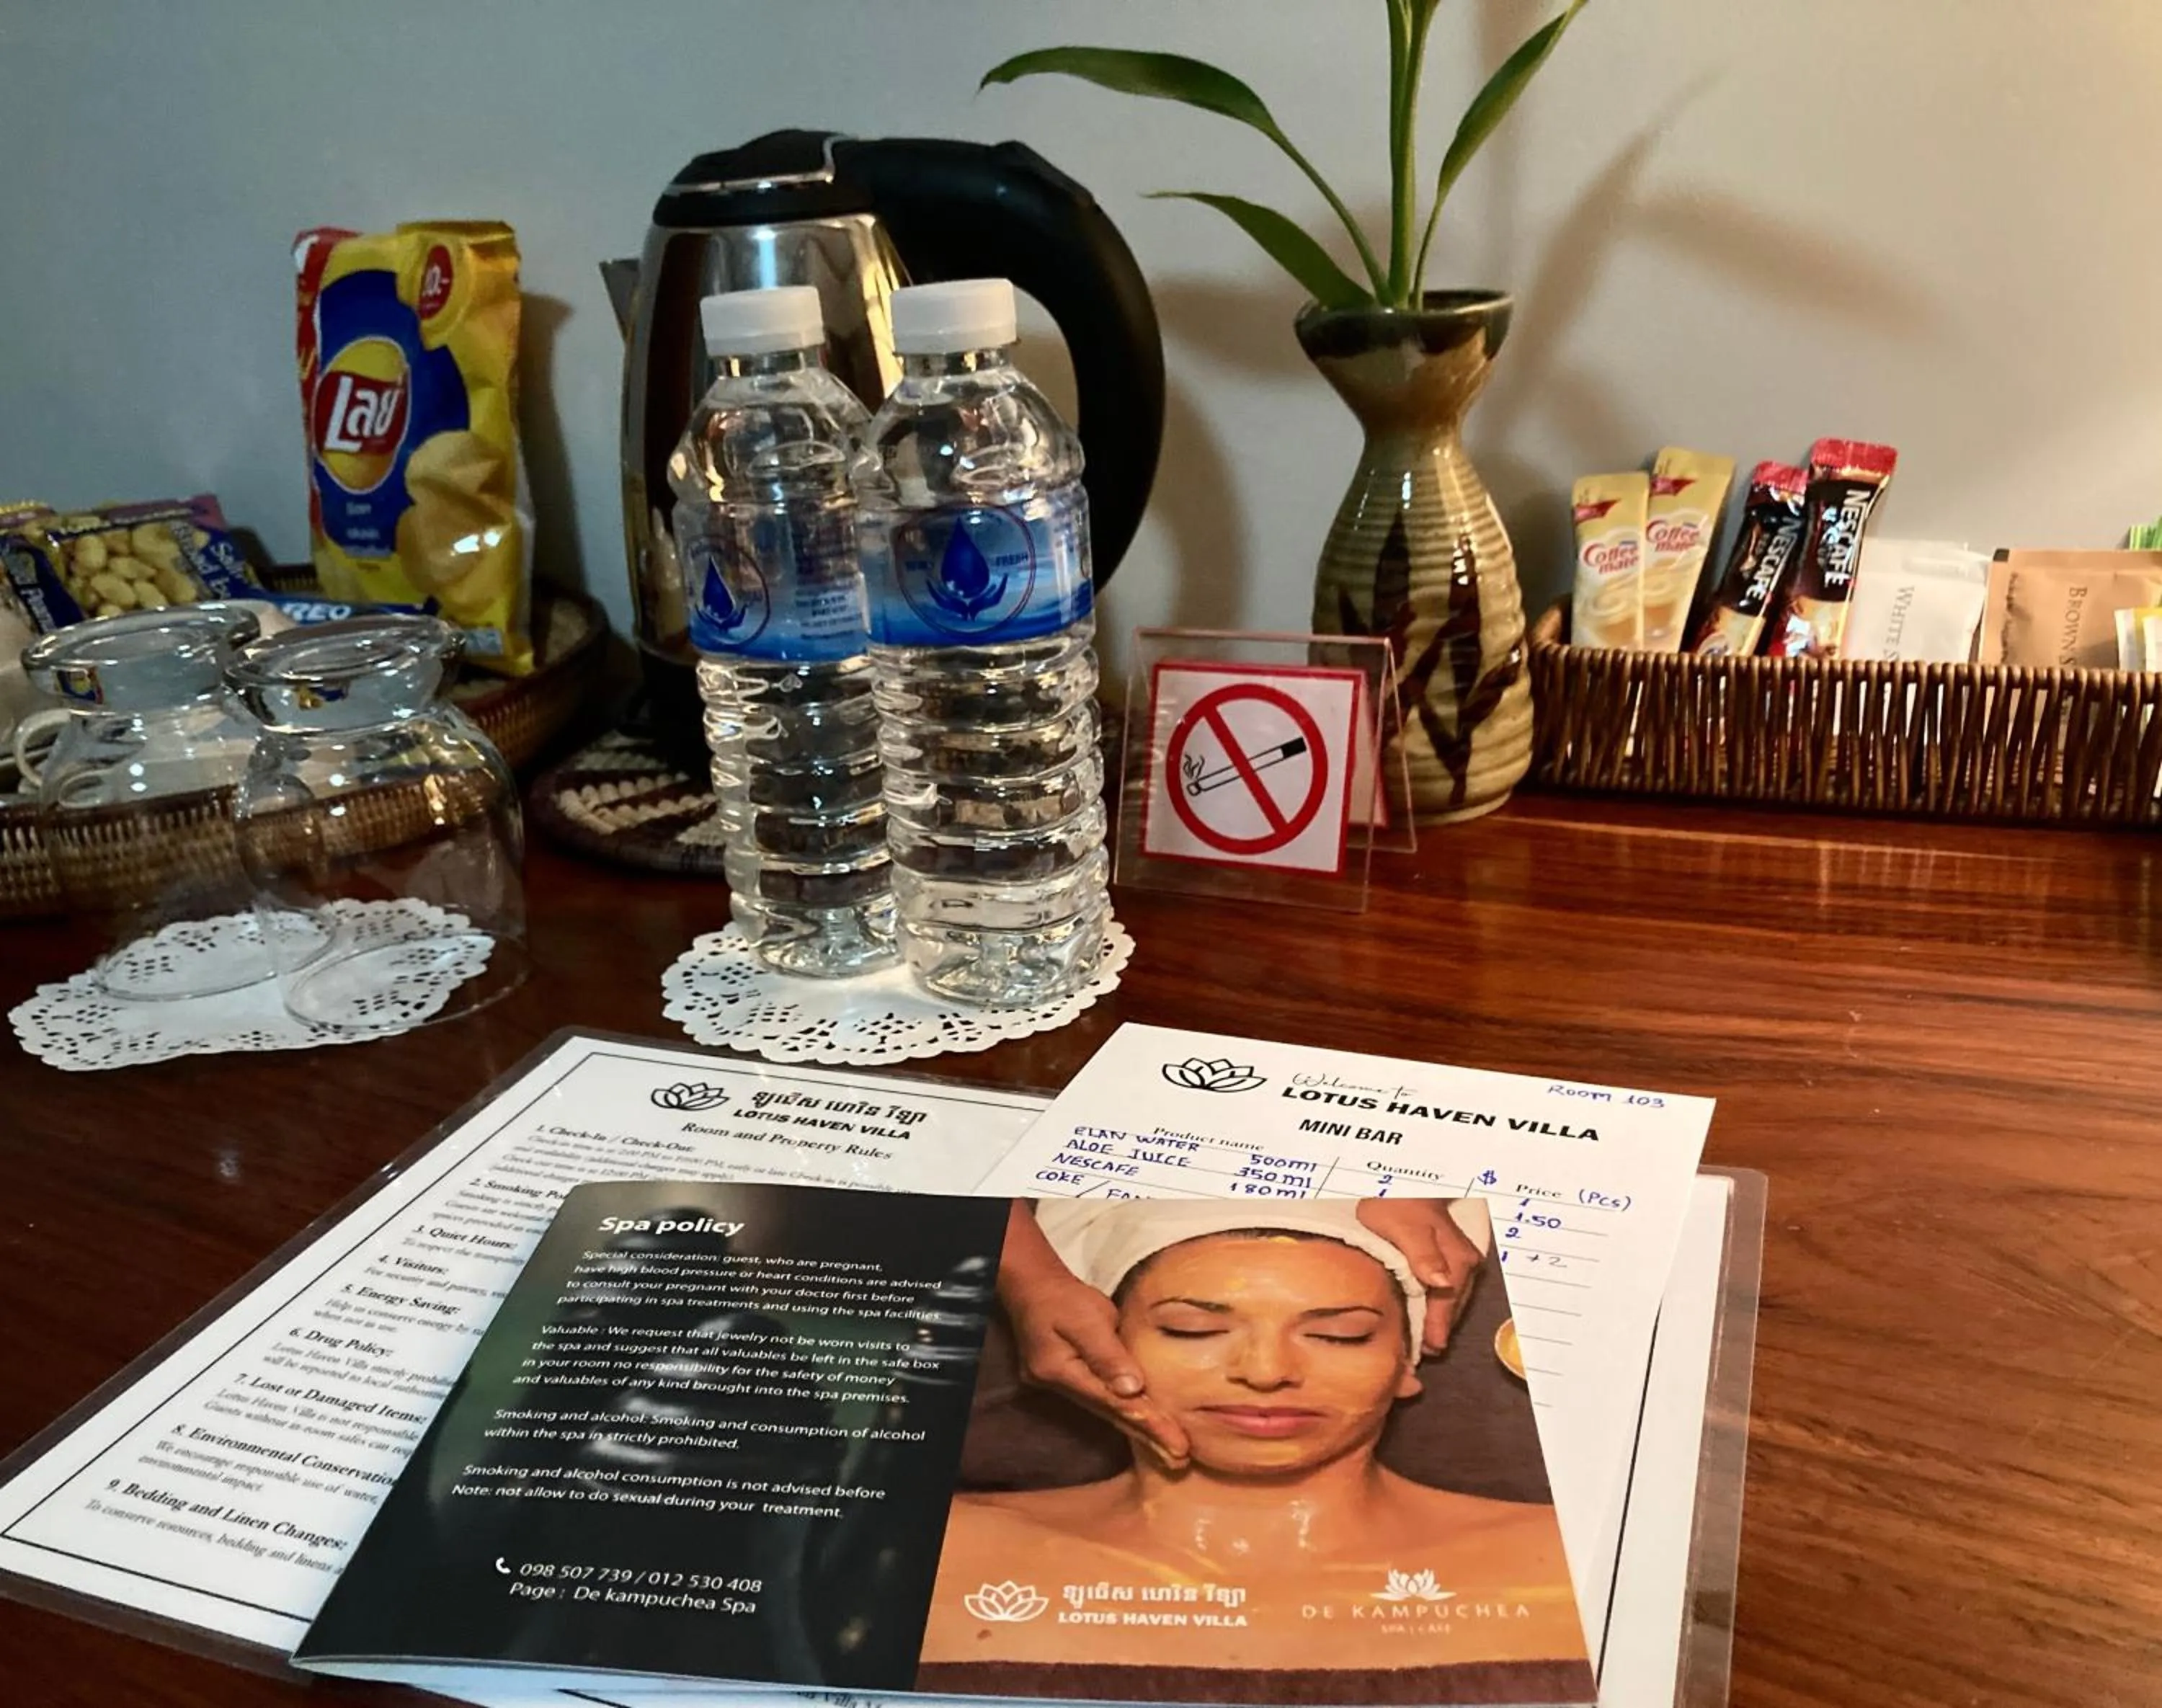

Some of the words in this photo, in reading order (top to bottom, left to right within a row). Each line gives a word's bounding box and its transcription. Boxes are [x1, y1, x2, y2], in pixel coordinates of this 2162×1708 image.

[1646, 520, 1700, 543] Coffee
[1583, 543, 1638, 567] Coffee
[1598, 556, 1640, 575] mate
[1884, 586, 1915, 646] WHITE
[2061, 586, 2088, 652] BROWN
[1292, 1072, 1388, 1094] Welcome
[1622, 1095, 1665, 1108] 103
[732, 1108, 790, 1124] LOTUS
[793, 1116, 856, 1133] HAVEN
[859, 1124, 911, 1140] VILLA
[1281, 1087, 1379, 1110] LOTUS
[1386, 1101, 1497, 1127] HAVEN
[1508, 1118, 1600, 1142] VILLA
[548, 1126, 608, 1142] Check-In
[681, 1121, 730, 1137] Room
[732, 1129, 765, 1142] and
[768, 1133, 840, 1155] Property
[845, 1144, 893, 1161] Rules
[1075, 1126, 1126, 1141] ELAN
[1136, 1135, 1200, 1152] WATER
[1153, 1127, 1216, 1144] Product
[1219, 1139, 1265, 1151] name
[1299, 1119, 1351, 1137] MINI
[1355, 1127, 1403, 1146] BAR
[1052, 1152, 1140, 1177] NESCAFE
[1067, 1139, 1115, 1155] ALOE
[1128, 1148, 1192, 1167] JUICE
[1366, 1160, 1443, 1181] Quantity
[1378, 1174, 1394, 1186] 2
[1477, 1170, 1498, 1186] $
[484, 1180, 543, 1198] Smoking
[1516, 1184, 1562, 1198] Price
[597, 1216, 651, 1235] Spa
[654, 1218, 746, 1237] policy
[1505, 1227, 1521, 1238] 2
[1515, 1212, 1562, 1229] 1.50
[429, 1227, 468, 1242] Quiet
[582, 1251, 628, 1260] Special
[766, 1257, 795, 1266] who
[574, 1266, 604, 1274] have
[608, 1265, 637, 1275] high
[640, 1266, 680, 1276] blood
[680, 1268, 737, 1278] pressure
[756, 1271, 791, 1281] heart
[794, 1273, 864, 1286] conditions
[890, 1280, 943, 1290] advised
[357, 1286, 408, 1307] Energy
[409, 1296, 461, 1315] Saving:
[303, 1330, 344, 1348] Drug
[344, 1339, 395, 1357] Policy:
[249, 1376, 284, 1392] Lost
[285, 1387, 303, 1397] or
[303, 1388, 378, 1414] Damaged
[378, 1403, 427, 1425] Items:
[494, 1409, 557, 1423] Smoking
[560, 1410, 589, 1421] and
[650, 1414, 716, 1430] Smoking
[718, 1418, 748, 1431] and
[750, 1422, 849, 1438] consumption
[851, 1426, 871, 1438] of
[870, 1429, 926, 1441] alcohol
[188, 1426, 302, 1464] Environmental
[462, 1464, 529, 1478] Smoking
[531, 1467, 563, 1479] and
[563, 1468, 620, 1481] alcohol
[621, 1472, 722, 1488] consumption
[726, 1478, 739, 1490] is
[742, 1481, 769, 1493] not
[771, 1482, 832, 1496] advised
[835, 1486, 886, 1500] before
[451, 1484, 492, 1497] Note:
[495, 1486, 522, 1498] not
[524, 1487, 567, 1499] allow
[569, 1490, 585, 1500] to
[588, 1489, 609, 1501] do
[613, 1492, 660, 1505] sexual
[664, 1495, 716, 1511] during
[719, 1500, 755, 1513] your
[762, 1503, 844, 1519] treatment.
[121, 1481, 188, 1512] Bedding
[188, 1503, 223, 1518] and
[221, 1508, 270, 1532] Linen
[272, 1521, 348, 1551] Changes:
[520, 1563, 556, 1578] 098
[559, 1565, 595, 1580] 507
[597, 1567, 633, 1583] 739
[648, 1571, 683, 1587] 012
[688, 1575, 723, 1591] 530
[726, 1578, 763, 1593] 408
[509, 1581, 556, 1600] Page
[573, 1586, 601, 1601] De
[604, 1588, 716, 1610] kampuchea
[721, 1596, 757, 1615] Spa
[1058, 1611, 1118, 1625] LOTUS
[1124, 1611, 1188, 1626] HAVEN
[1192, 1613, 1248, 1627] VILLA
[1302, 1604, 1334, 1619] DE
[1352, 1604, 1531, 1619] KAMPUCHEA
